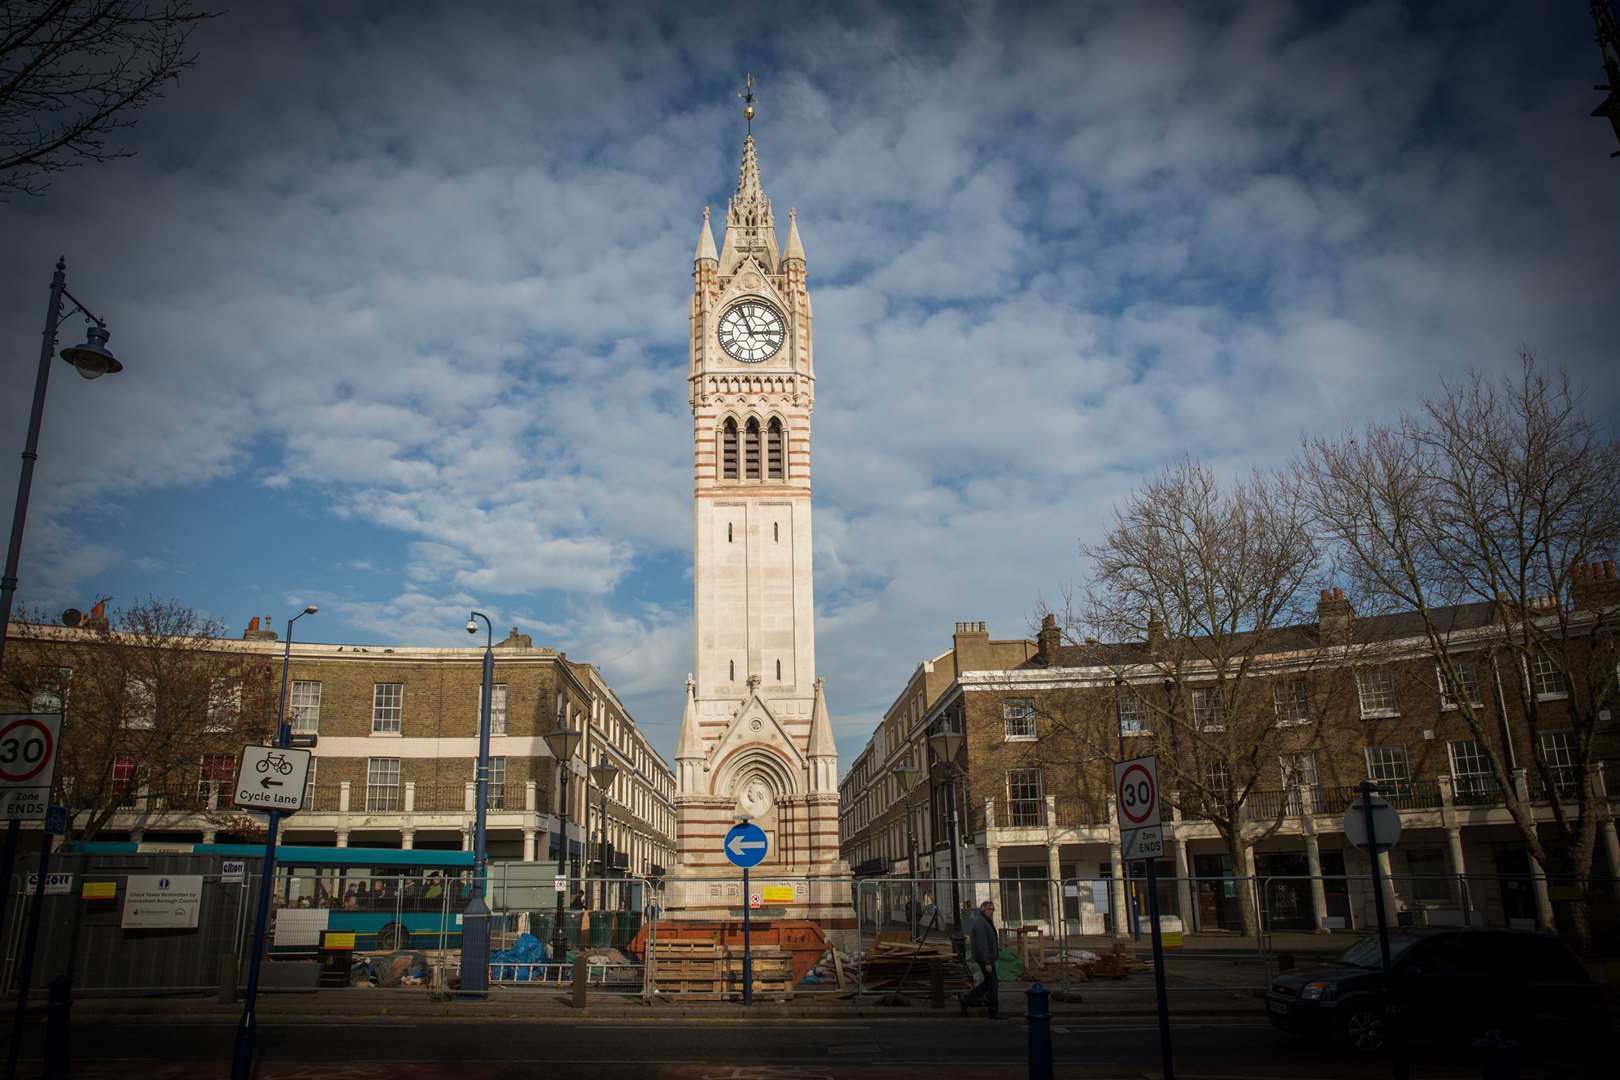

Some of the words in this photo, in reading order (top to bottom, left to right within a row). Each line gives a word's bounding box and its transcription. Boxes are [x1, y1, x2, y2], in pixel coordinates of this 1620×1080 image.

[0, 738, 44, 764] 30
[15, 792, 40, 801] Zone
[239, 789, 271, 802] Cycle
[273, 793, 298, 804] lane
[1124, 780, 1150, 807] 30
[7, 803, 45, 814] ENDS
[1139, 841, 1161, 853] ENDS
